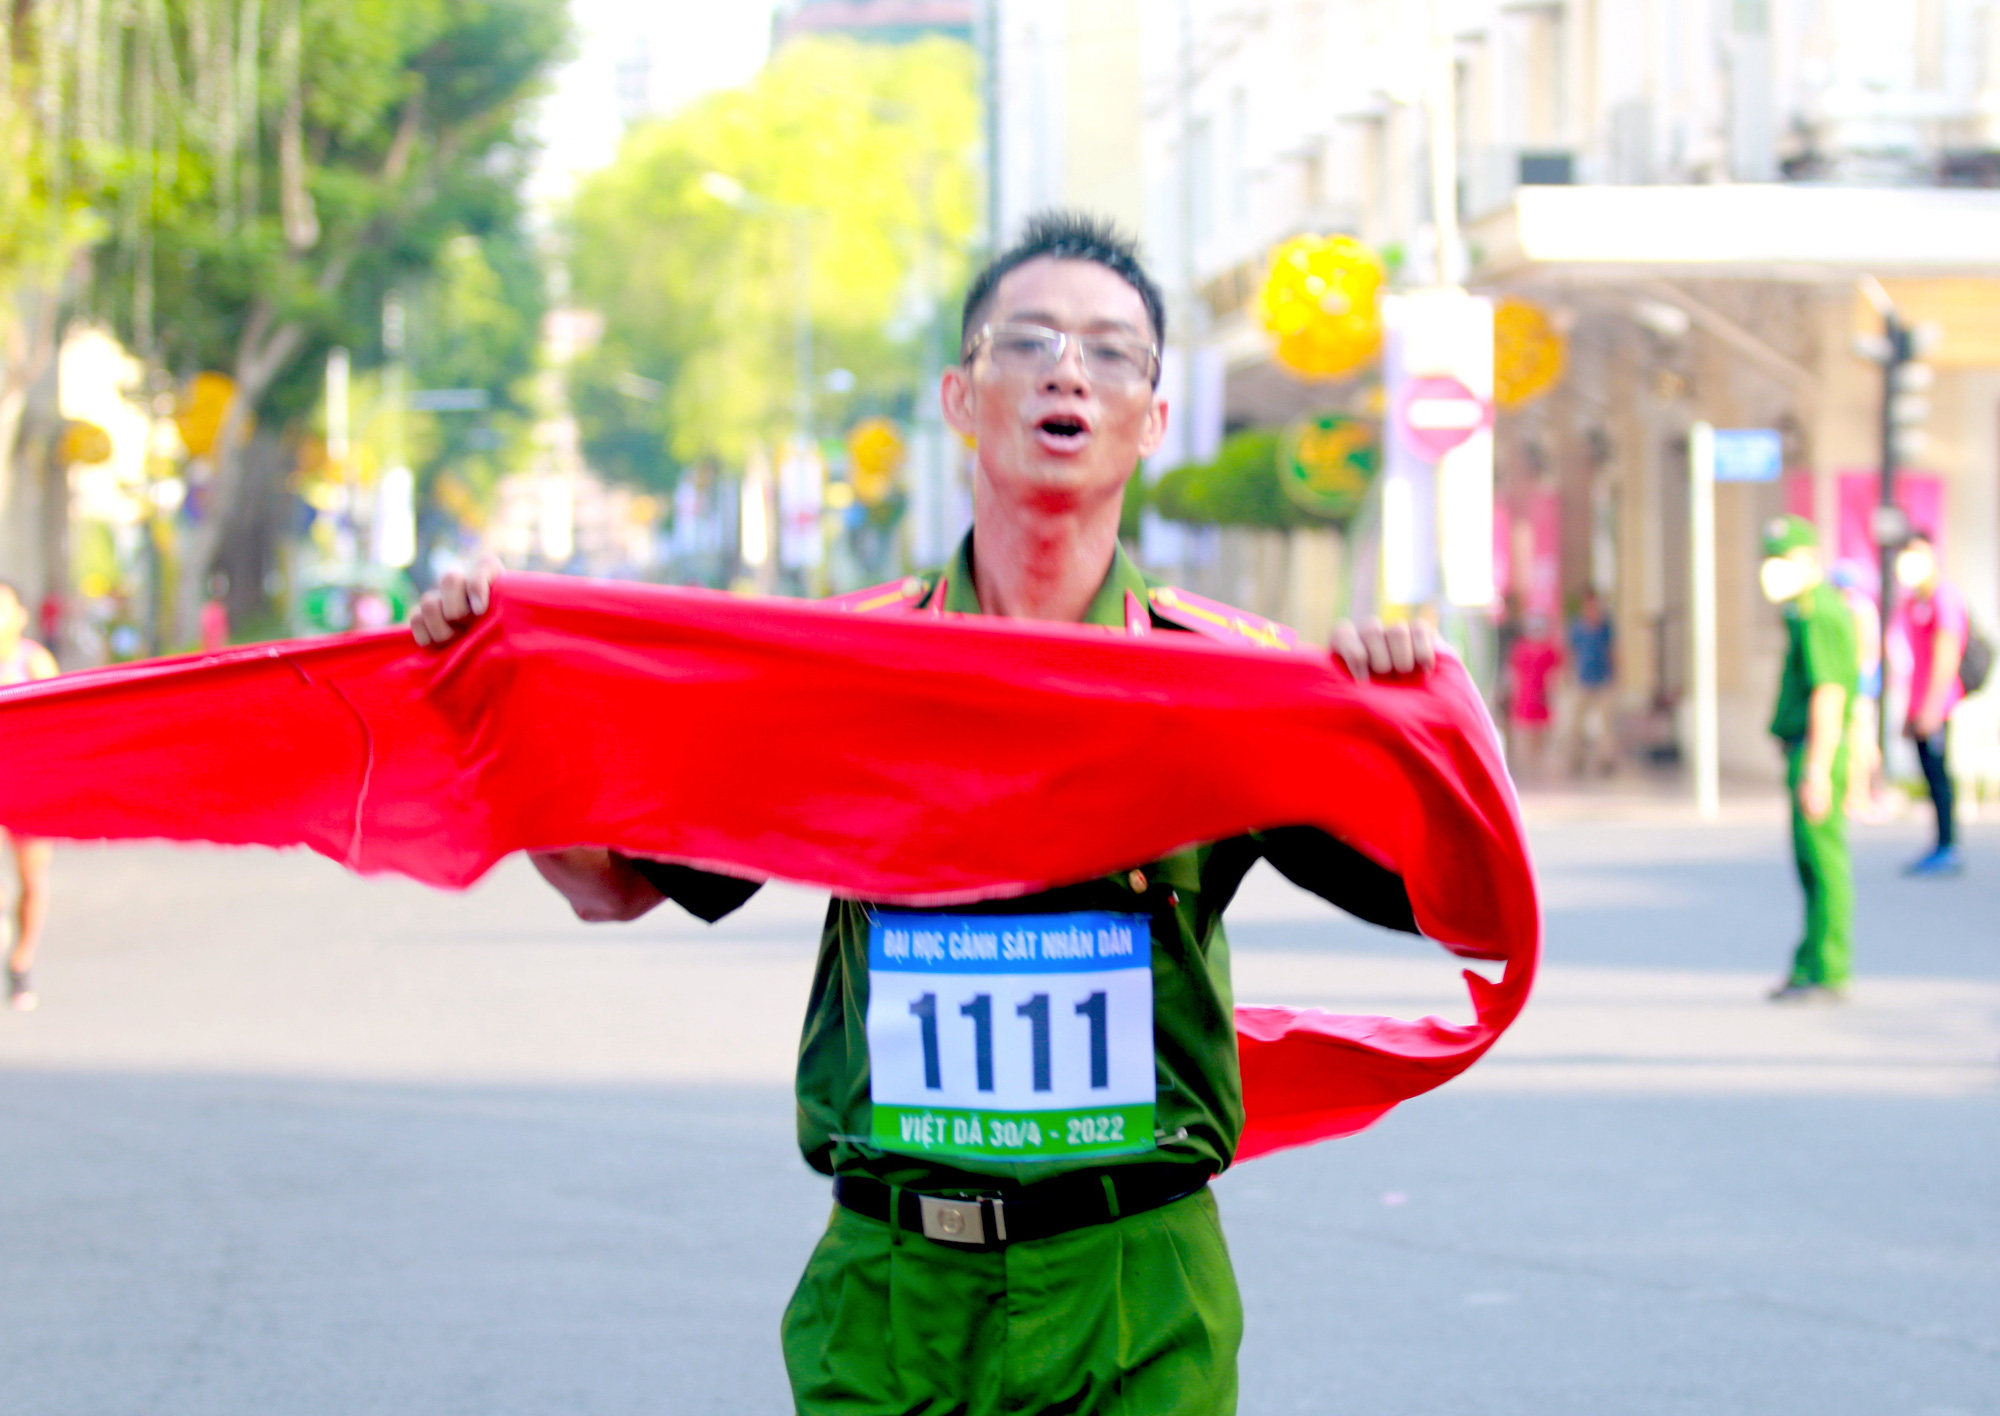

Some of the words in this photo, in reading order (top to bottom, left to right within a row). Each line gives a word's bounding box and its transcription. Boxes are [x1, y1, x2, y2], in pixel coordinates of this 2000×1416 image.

[912, 930, 945, 965] HỌC
[1002, 925, 1037, 960] SÁT
[1041, 924, 1094, 959] NHÂN
[1098, 920, 1133, 957] DÂN
[909, 989, 1109, 1092] 1111
[900, 1110, 947, 1148] VIỆT
[989, 1119, 1042, 1148] 30/4
[1066, 1115, 1124, 1146] 2022
